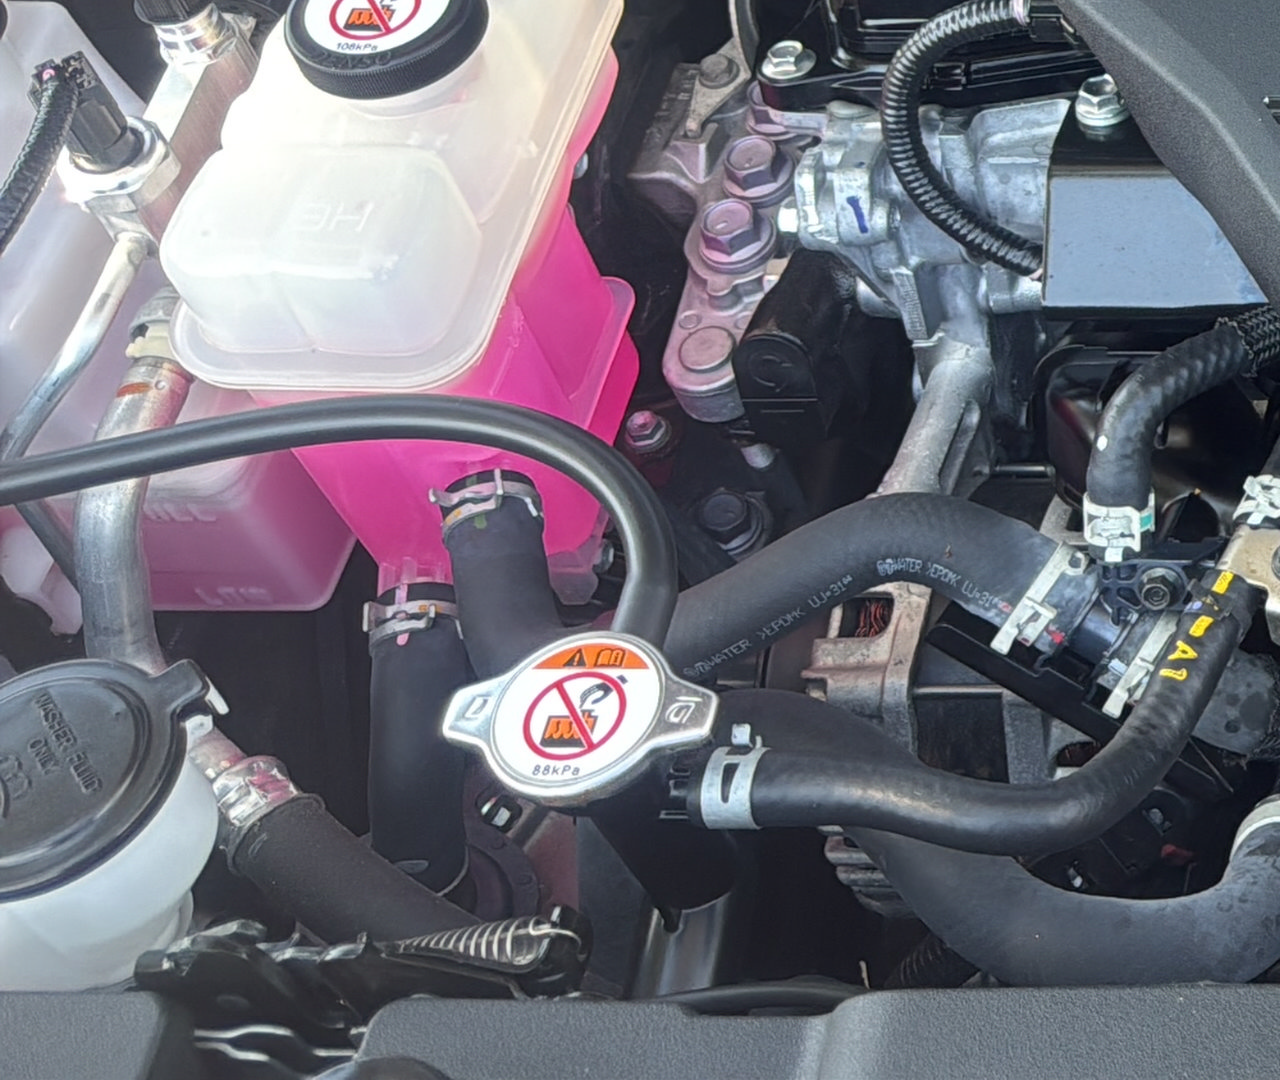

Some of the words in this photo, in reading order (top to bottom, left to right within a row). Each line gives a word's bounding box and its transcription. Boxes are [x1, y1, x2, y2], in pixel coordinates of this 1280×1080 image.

[336, 42, 378, 52] 108kPa
[33, 690, 77, 752] WASHER
[28, 737, 60, 775] ONLY
[532, 764, 580, 776] 88kPa
